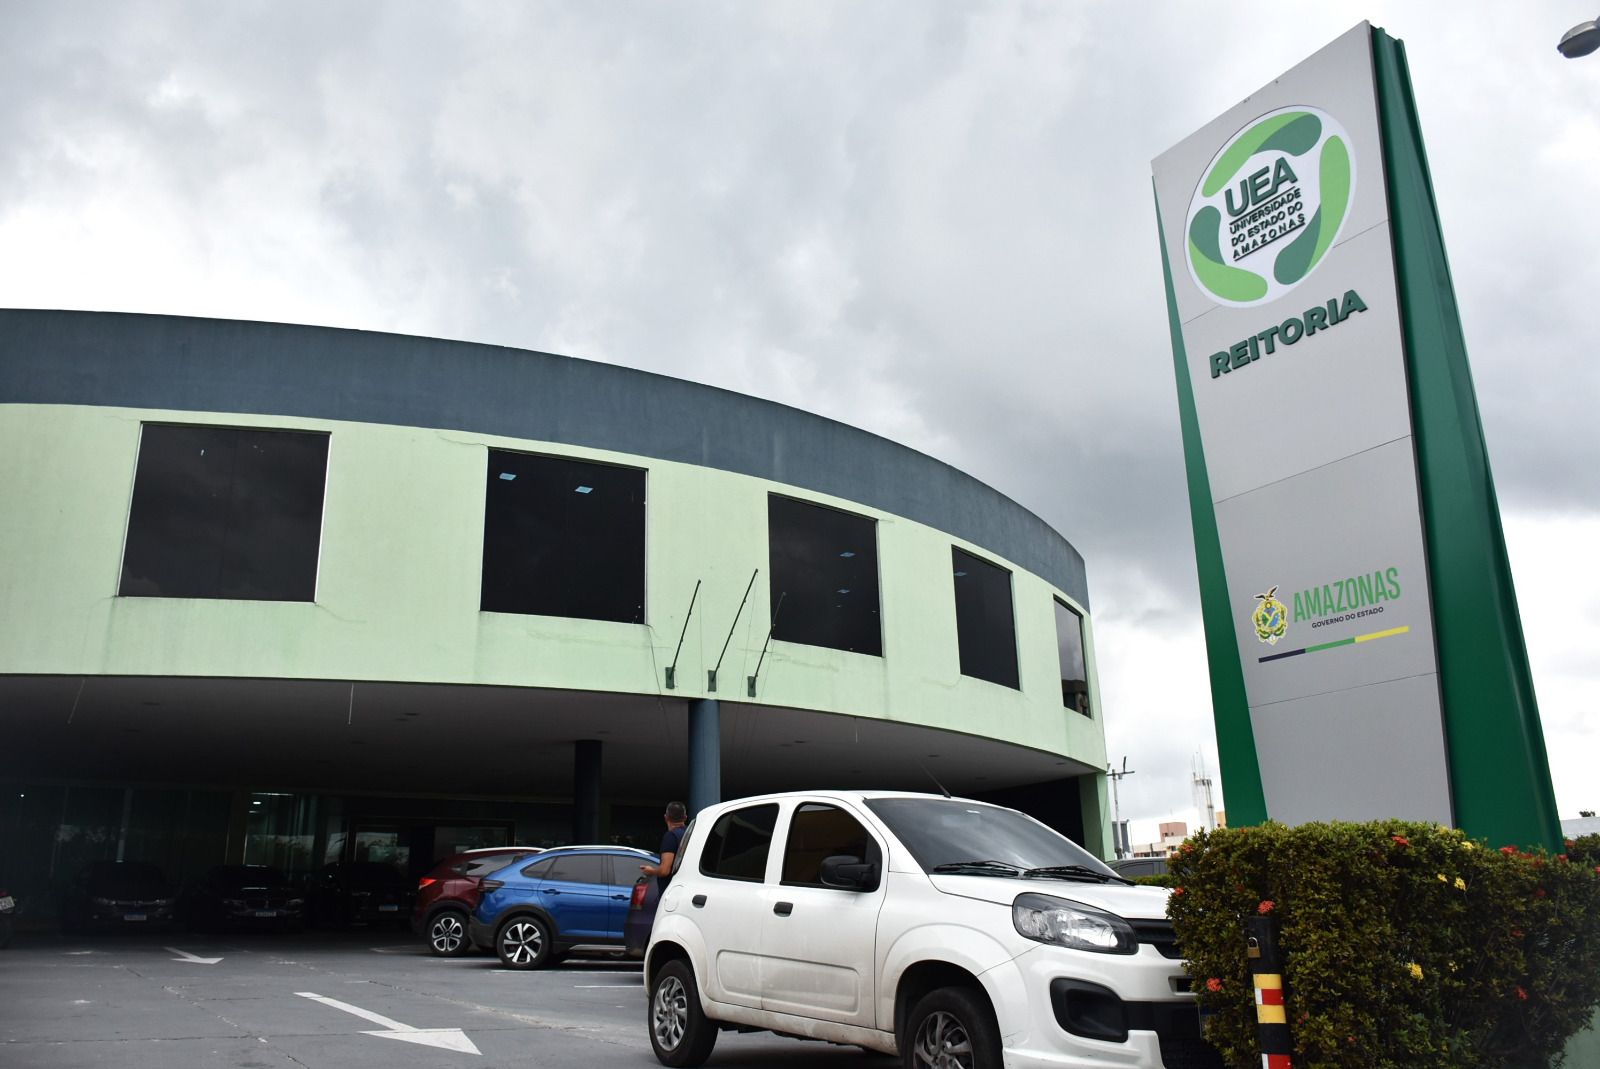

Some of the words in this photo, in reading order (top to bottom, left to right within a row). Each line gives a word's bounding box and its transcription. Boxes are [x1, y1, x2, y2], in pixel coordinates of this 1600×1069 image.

[1224, 157, 1298, 217] UEA
[1229, 187, 1302, 235] UNIVERSIDADE
[1231, 233, 1246, 247] DO
[1247, 211, 1286, 238] ESTADO
[1287, 201, 1303, 216] DO
[1233, 213, 1306, 259] AMAZONAS
[1209, 289, 1368, 379] REITORIA
[1293, 567, 1401, 623] AMAZONAS
[1311, 615, 1344, 629] GOVERNO
[1345, 612, 1356, 621] DO
[1357, 606, 1385, 619] ESTADO
